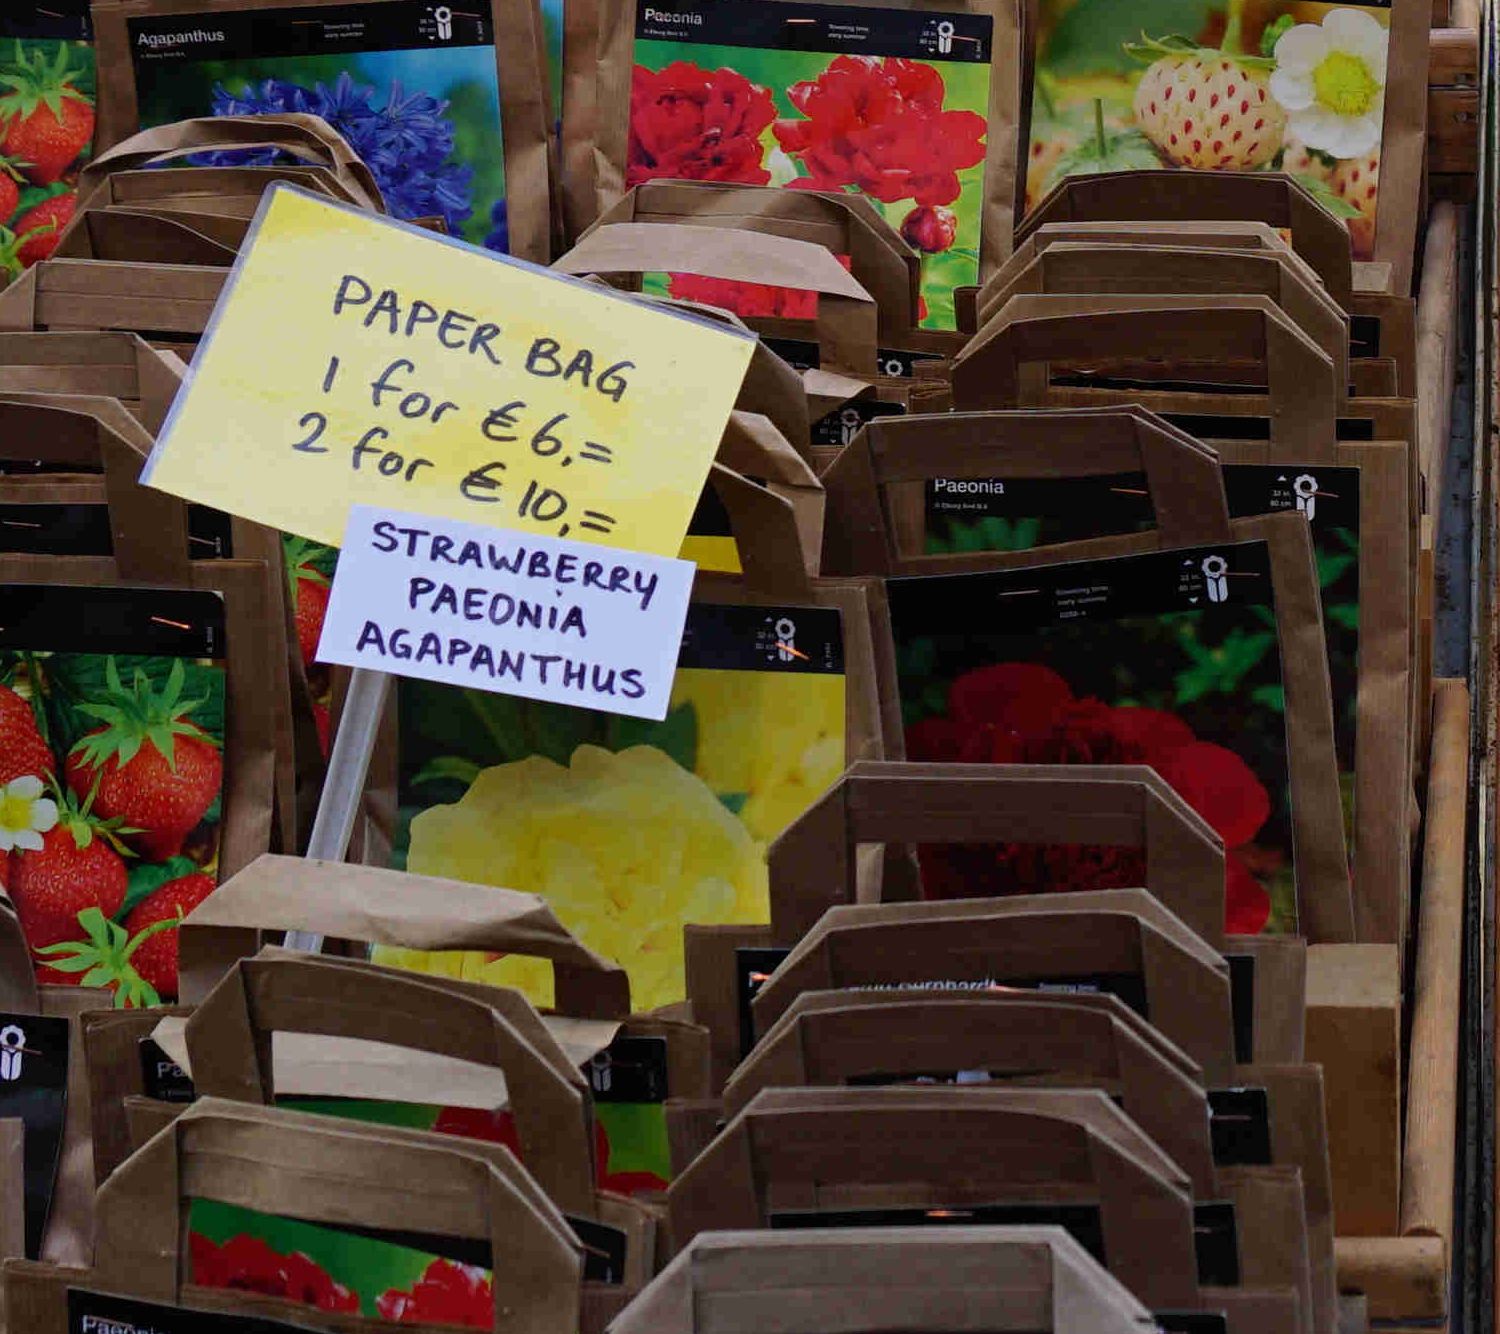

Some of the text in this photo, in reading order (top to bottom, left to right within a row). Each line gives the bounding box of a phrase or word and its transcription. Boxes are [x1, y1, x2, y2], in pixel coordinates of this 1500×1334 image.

[137, 29, 226, 49] Agapanthus
[644, 7, 704, 26] Paeonia
[332, 273, 638, 403] PAPER BAG
[321, 355, 341, 394] 1
[370, 358, 461, 424] for
[291, 410, 331, 455] 2
[351, 425, 437, 483] for
[933, 479, 1006, 496] Paeonia
[371, 521, 660, 612] STRAWBERRY
[356, 620, 648, 699] AGAPANTHUS
